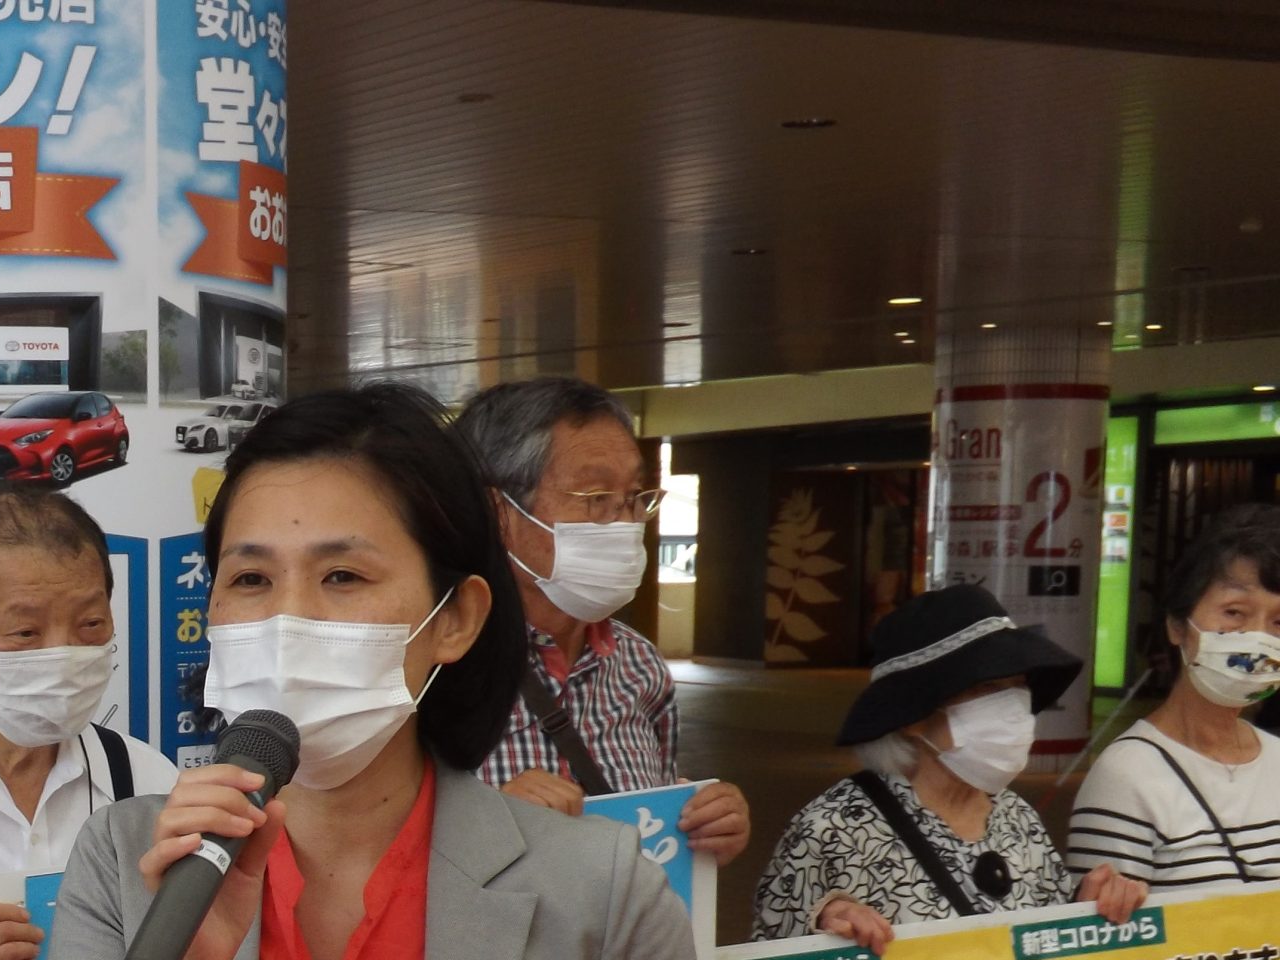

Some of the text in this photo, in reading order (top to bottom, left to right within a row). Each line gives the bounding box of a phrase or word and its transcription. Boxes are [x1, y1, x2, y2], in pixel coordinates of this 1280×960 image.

[22, 341, 59, 351] TOYOTA
[1022, 917, 1158, 957] 新型コロナから
